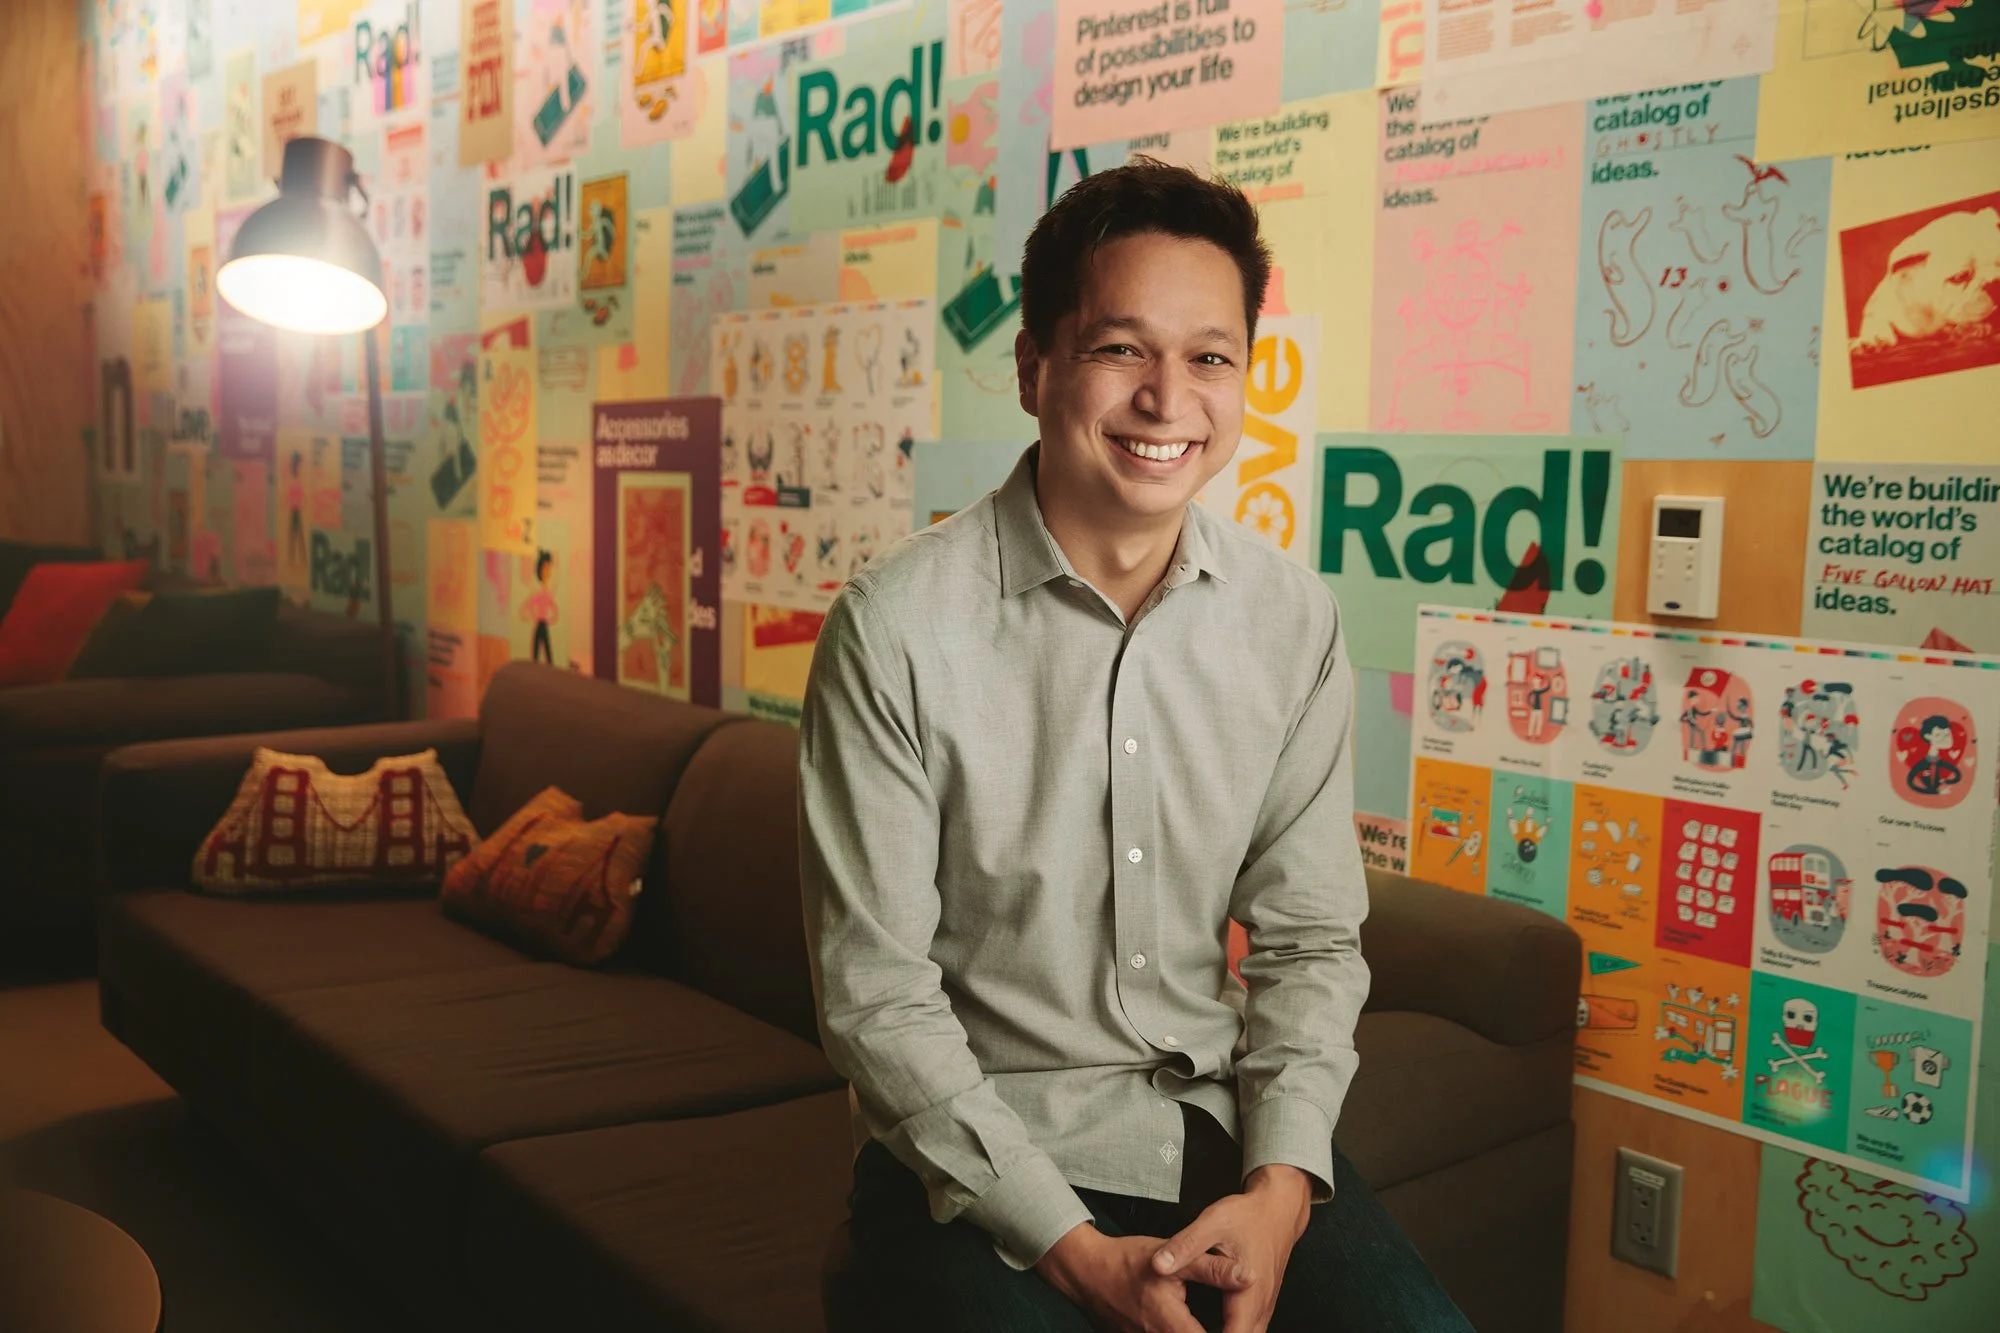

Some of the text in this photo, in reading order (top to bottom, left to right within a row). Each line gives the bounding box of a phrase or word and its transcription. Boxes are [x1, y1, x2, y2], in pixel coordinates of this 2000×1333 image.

[1077, 1, 1169, 44] Pinterest
[1174, 0, 1190, 21] is
[1075, 17, 1256, 76] of possibilities to
[1074, 54, 1233, 108] design your life
[796, 41, 943, 168] Rad!
[1386, 92, 1421, 113] We'
[1594, 104, 1681, 132] catalog
[1685, 92, 1711, 118] of
[1894, 86, 2000, 124] gsellent
[1216, 112, 1329, 142] We're building
[1386, 119, 1415, 138] the
[1216, 138, 1302, 164] the world's
[1384, 128, 1480, 162] catalog of
[1224, 160, 1293, 184] atalog of
[1592, 161, 1660, 185] ideas.
[1383, 188, 1438, 209] ideas.
[487, 173, 572, 261] Rad!
[1234, 335, 1303, 550] ove
[1824, 474, 1903, 500] We're
[1320, 446, 1611, 595] Rad!
[1822, 503, 1977, 532] the world's
[1819, 533, 1962, 564] catalog of
[1822, 563, 1995, 596] FIVE GALLON HAT
[1815, 586, 1897, 615] ideas.
[1755, 1074, 1834, 1109] PLAGUE
